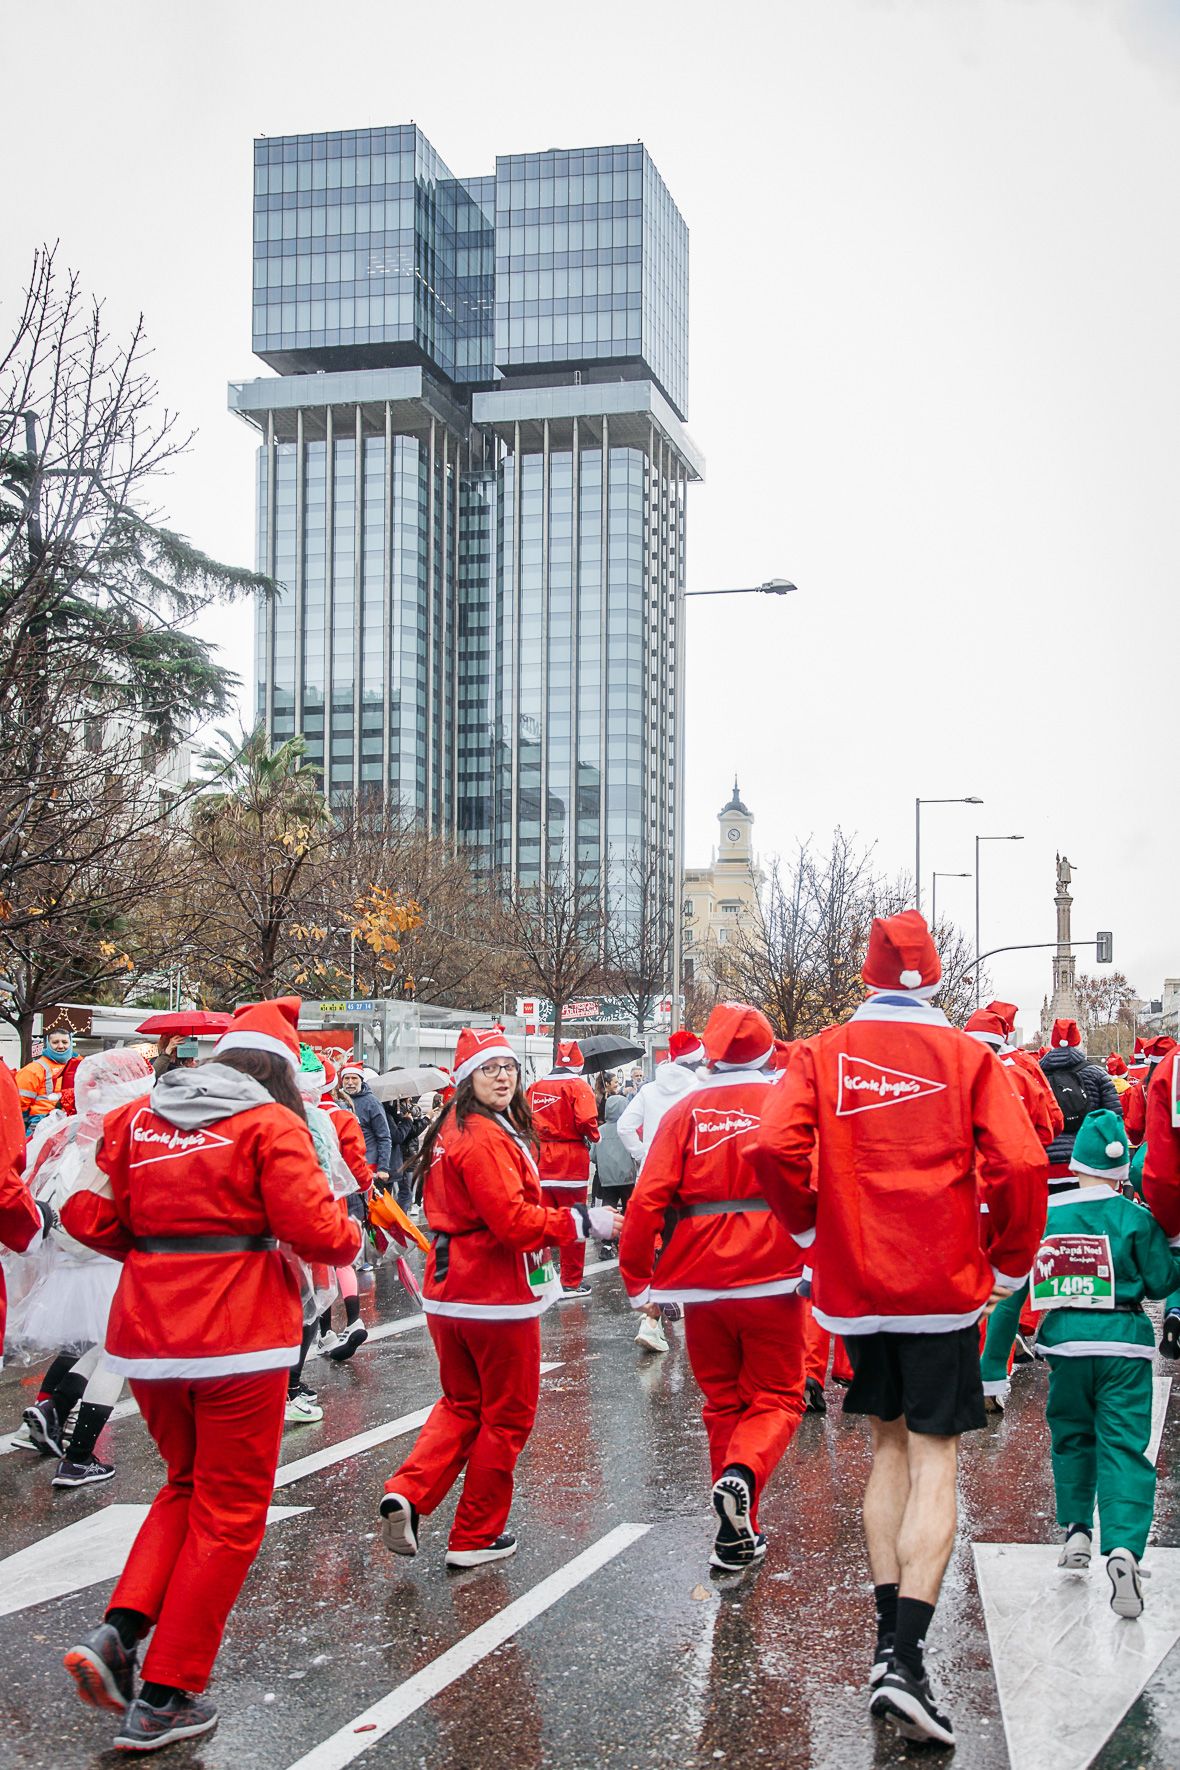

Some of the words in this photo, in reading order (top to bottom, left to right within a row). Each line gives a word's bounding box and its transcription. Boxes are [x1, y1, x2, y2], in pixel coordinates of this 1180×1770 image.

[853, 1076, 880, 1091] Corte
[879, 1076, 920, 1096] Inglés
[708, 1122, 725, 1132] Corte
[144, 1129, 171, 1144] Corte
[168, 1129, 205, 1149] Inglés
[1060, 1246, 1083, 1256] Papá
[1083, 1246, 1103, 1255] Noel
[1050, 1277, 1094, 1295] 1405
